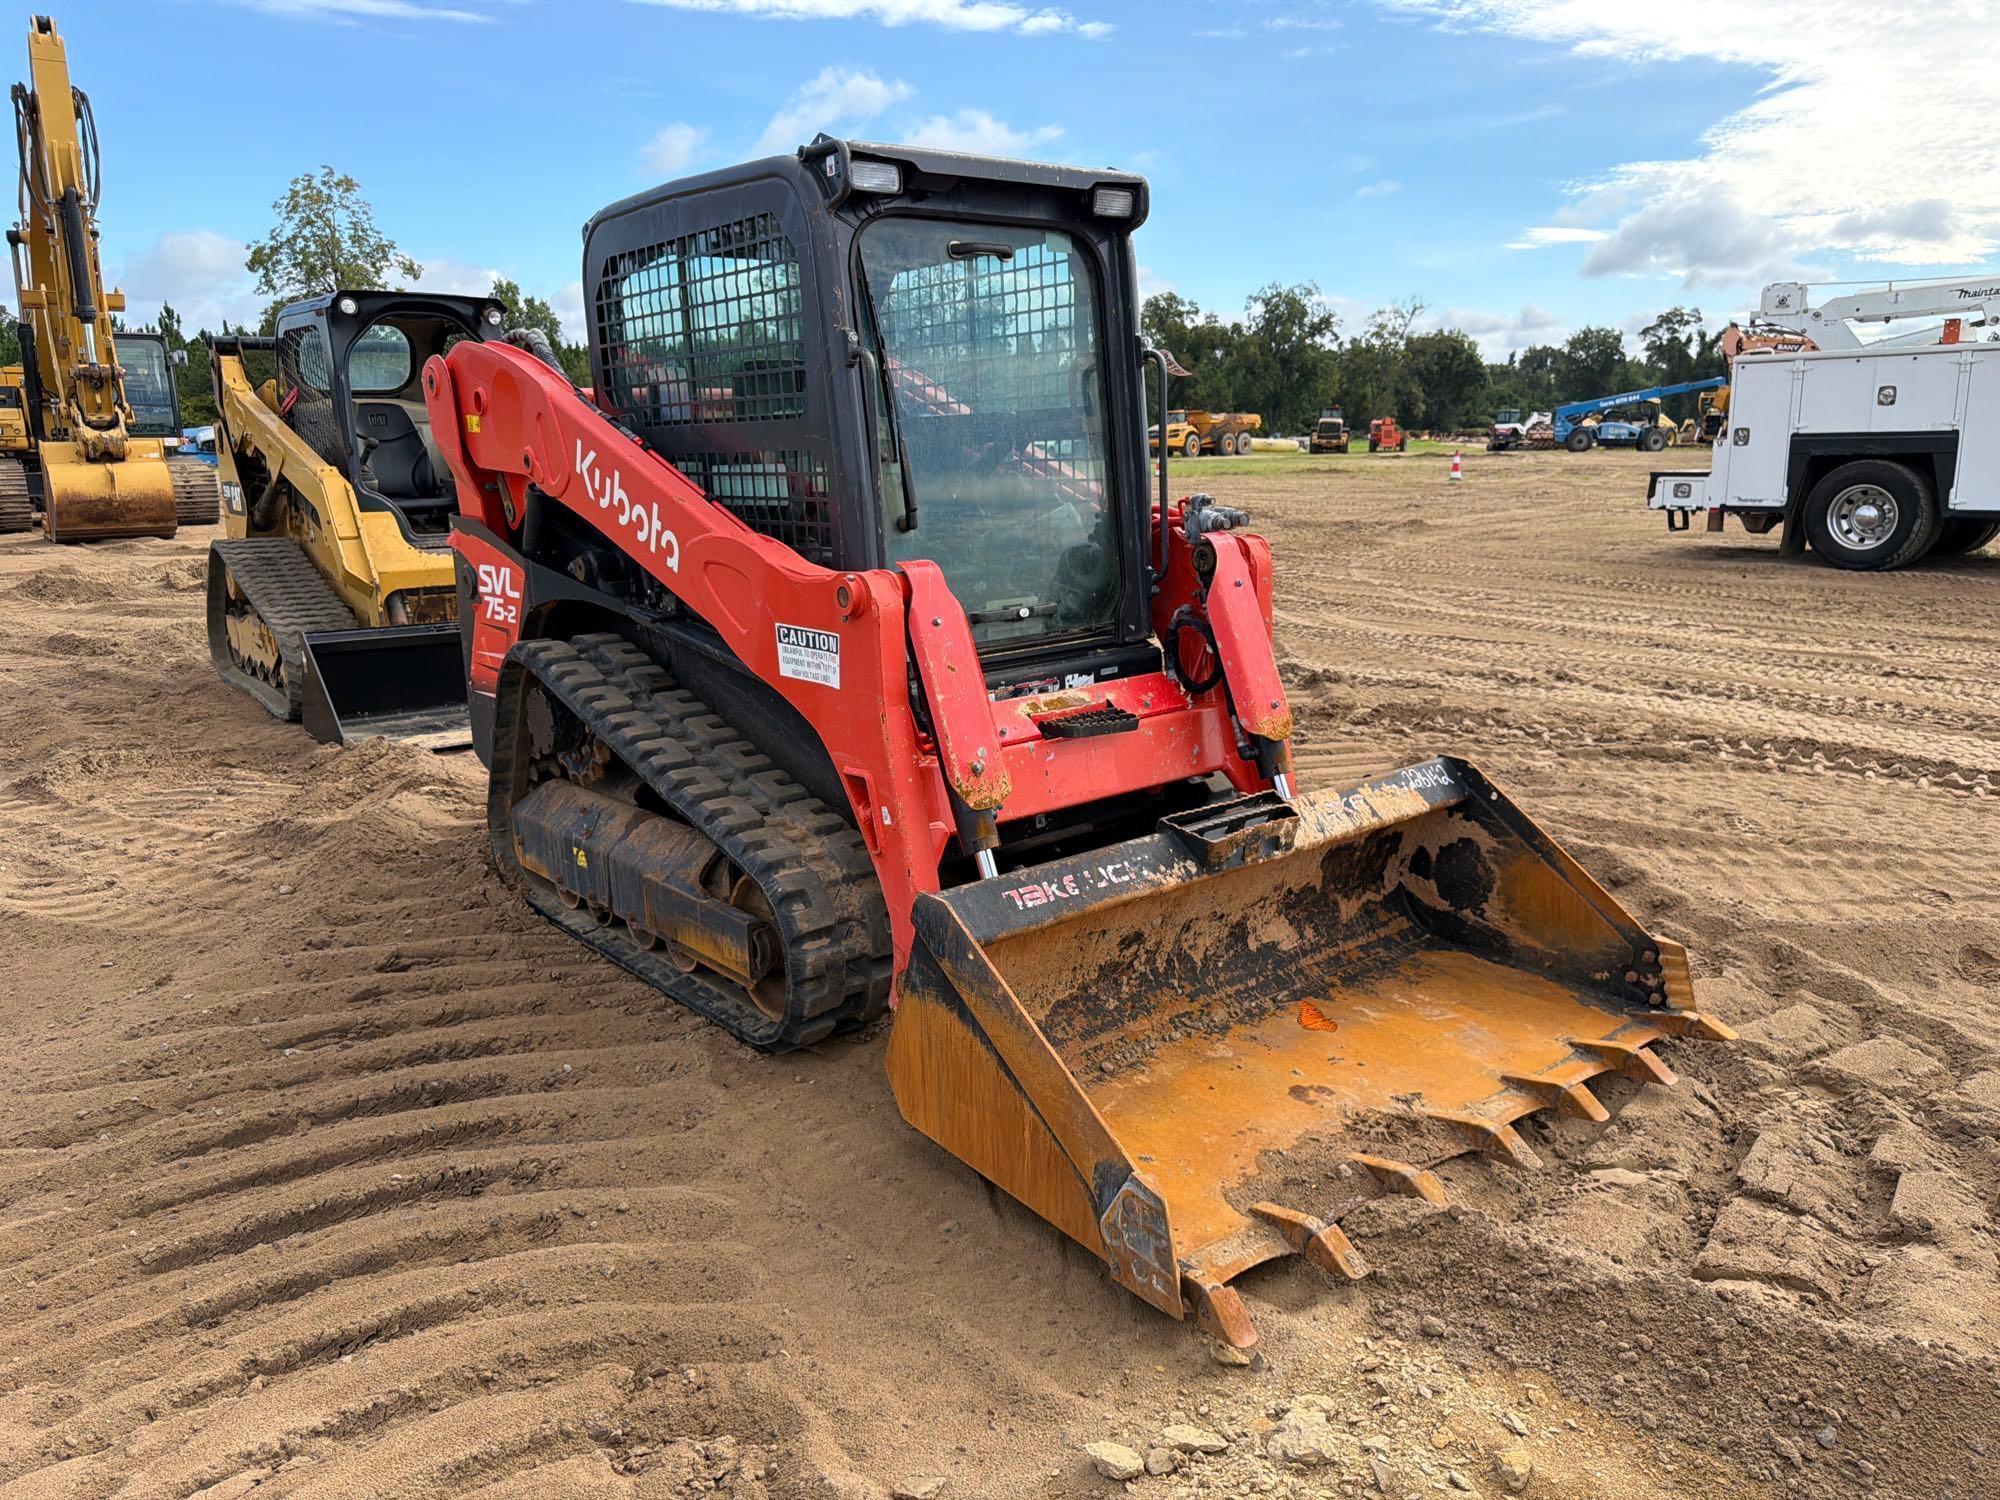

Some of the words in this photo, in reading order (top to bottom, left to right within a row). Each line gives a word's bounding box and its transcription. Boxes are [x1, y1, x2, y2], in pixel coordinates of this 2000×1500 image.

[576, 438, 679, 574] Kubota
[478, 564, 520, 599] SVL
[484, 595, 516, 624] 75-2
[780, 628, 836, 652] CAUTION
